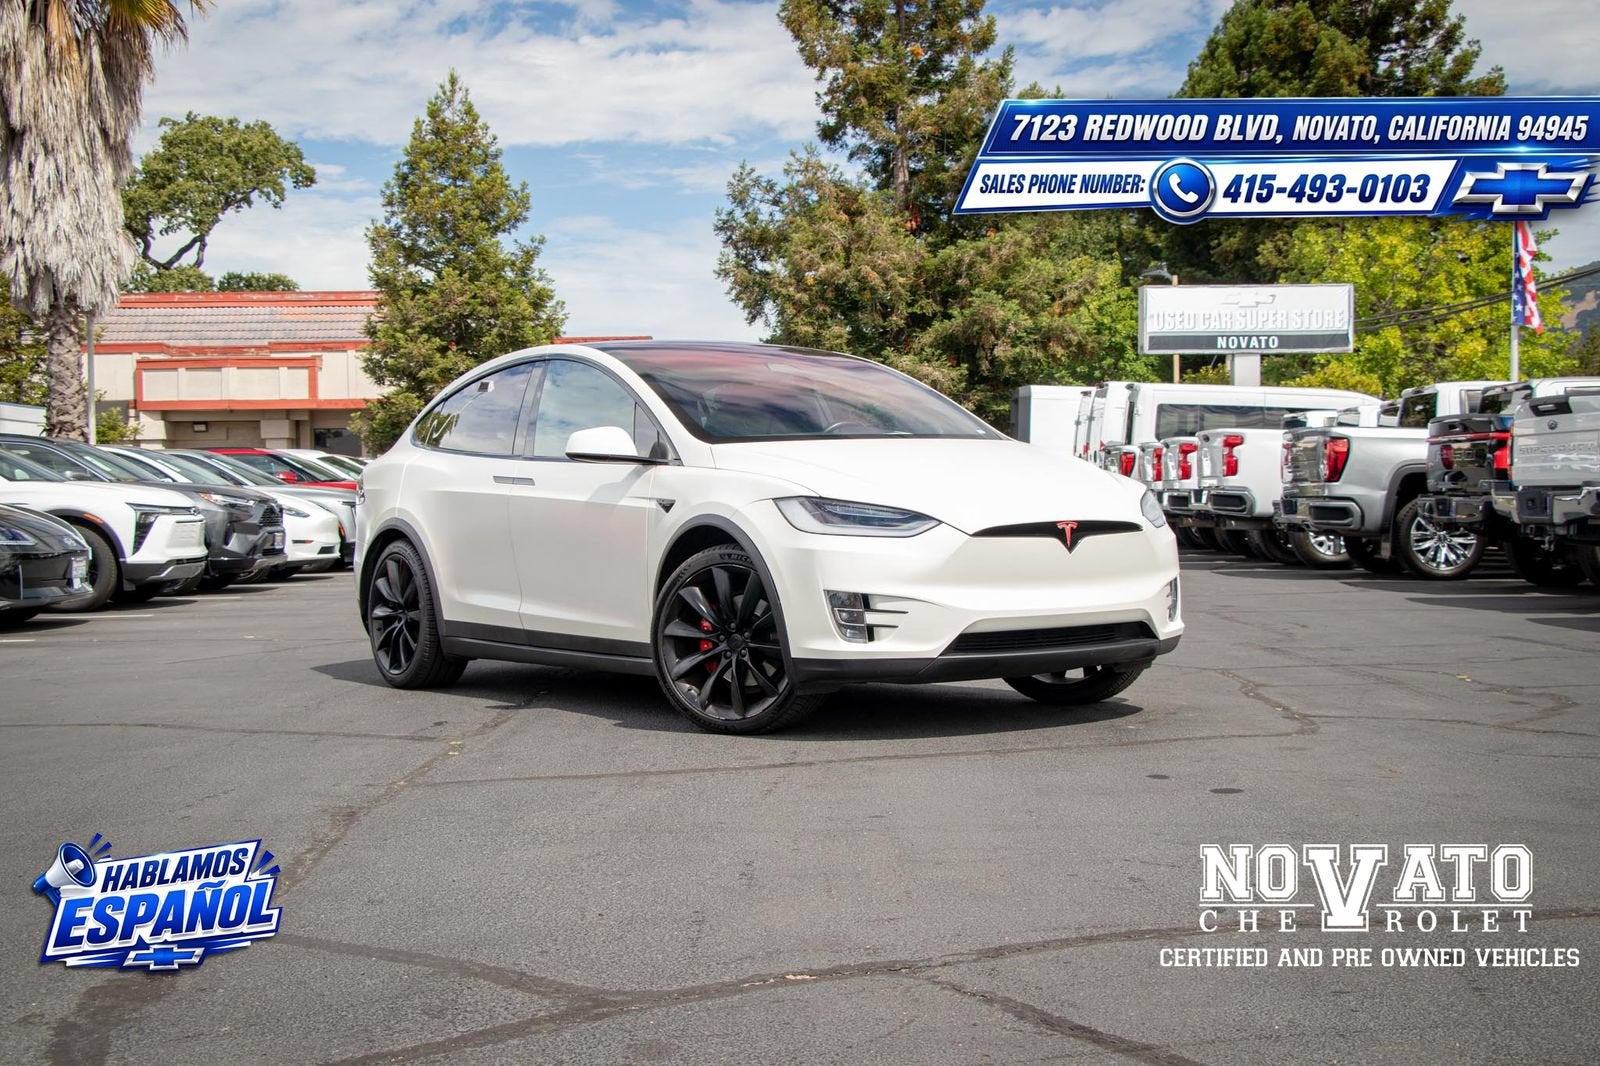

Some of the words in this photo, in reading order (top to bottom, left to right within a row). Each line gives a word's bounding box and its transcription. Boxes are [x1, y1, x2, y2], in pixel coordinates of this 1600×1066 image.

[1154, 311, 1197, 331] USED
[1200, 311, 1233, 330] CAR
[1237, 310, 1289, 330] SUPER
[1294, 309, 1345, 329] STORE
[1216, 335, 1279, 350] NOVATO
